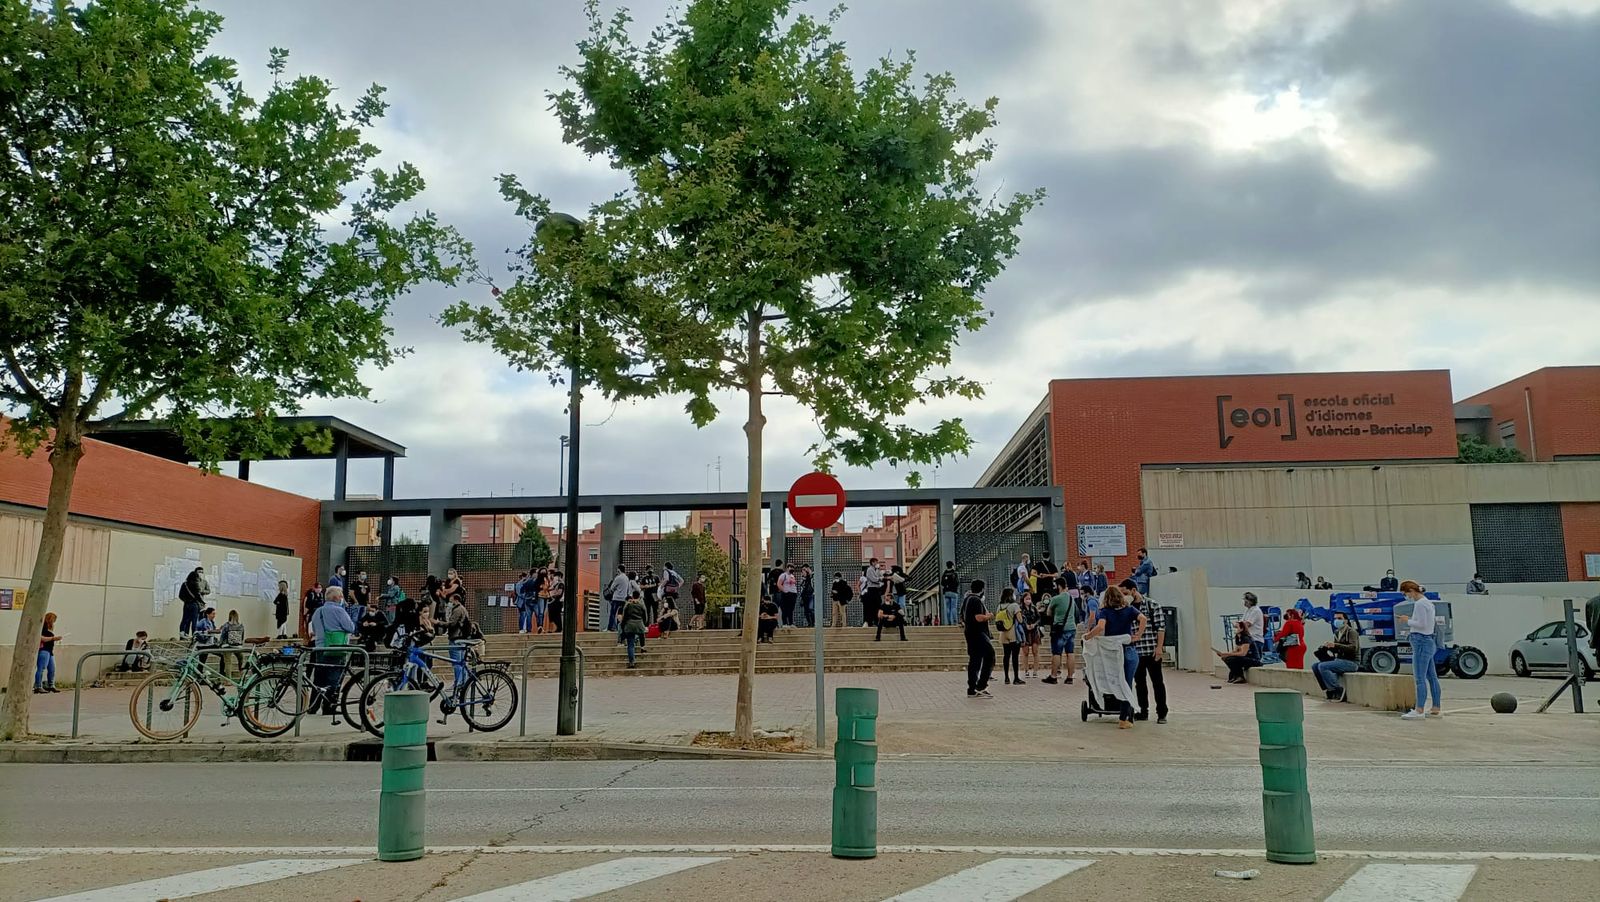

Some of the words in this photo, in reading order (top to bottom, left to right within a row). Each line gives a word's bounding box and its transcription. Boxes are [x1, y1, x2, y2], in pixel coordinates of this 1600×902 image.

[1304, 395, 1347, 406] escola
[1353, 393, 1395, 406] oficial
[1305, 410, 1373, 422] d'idiomes
